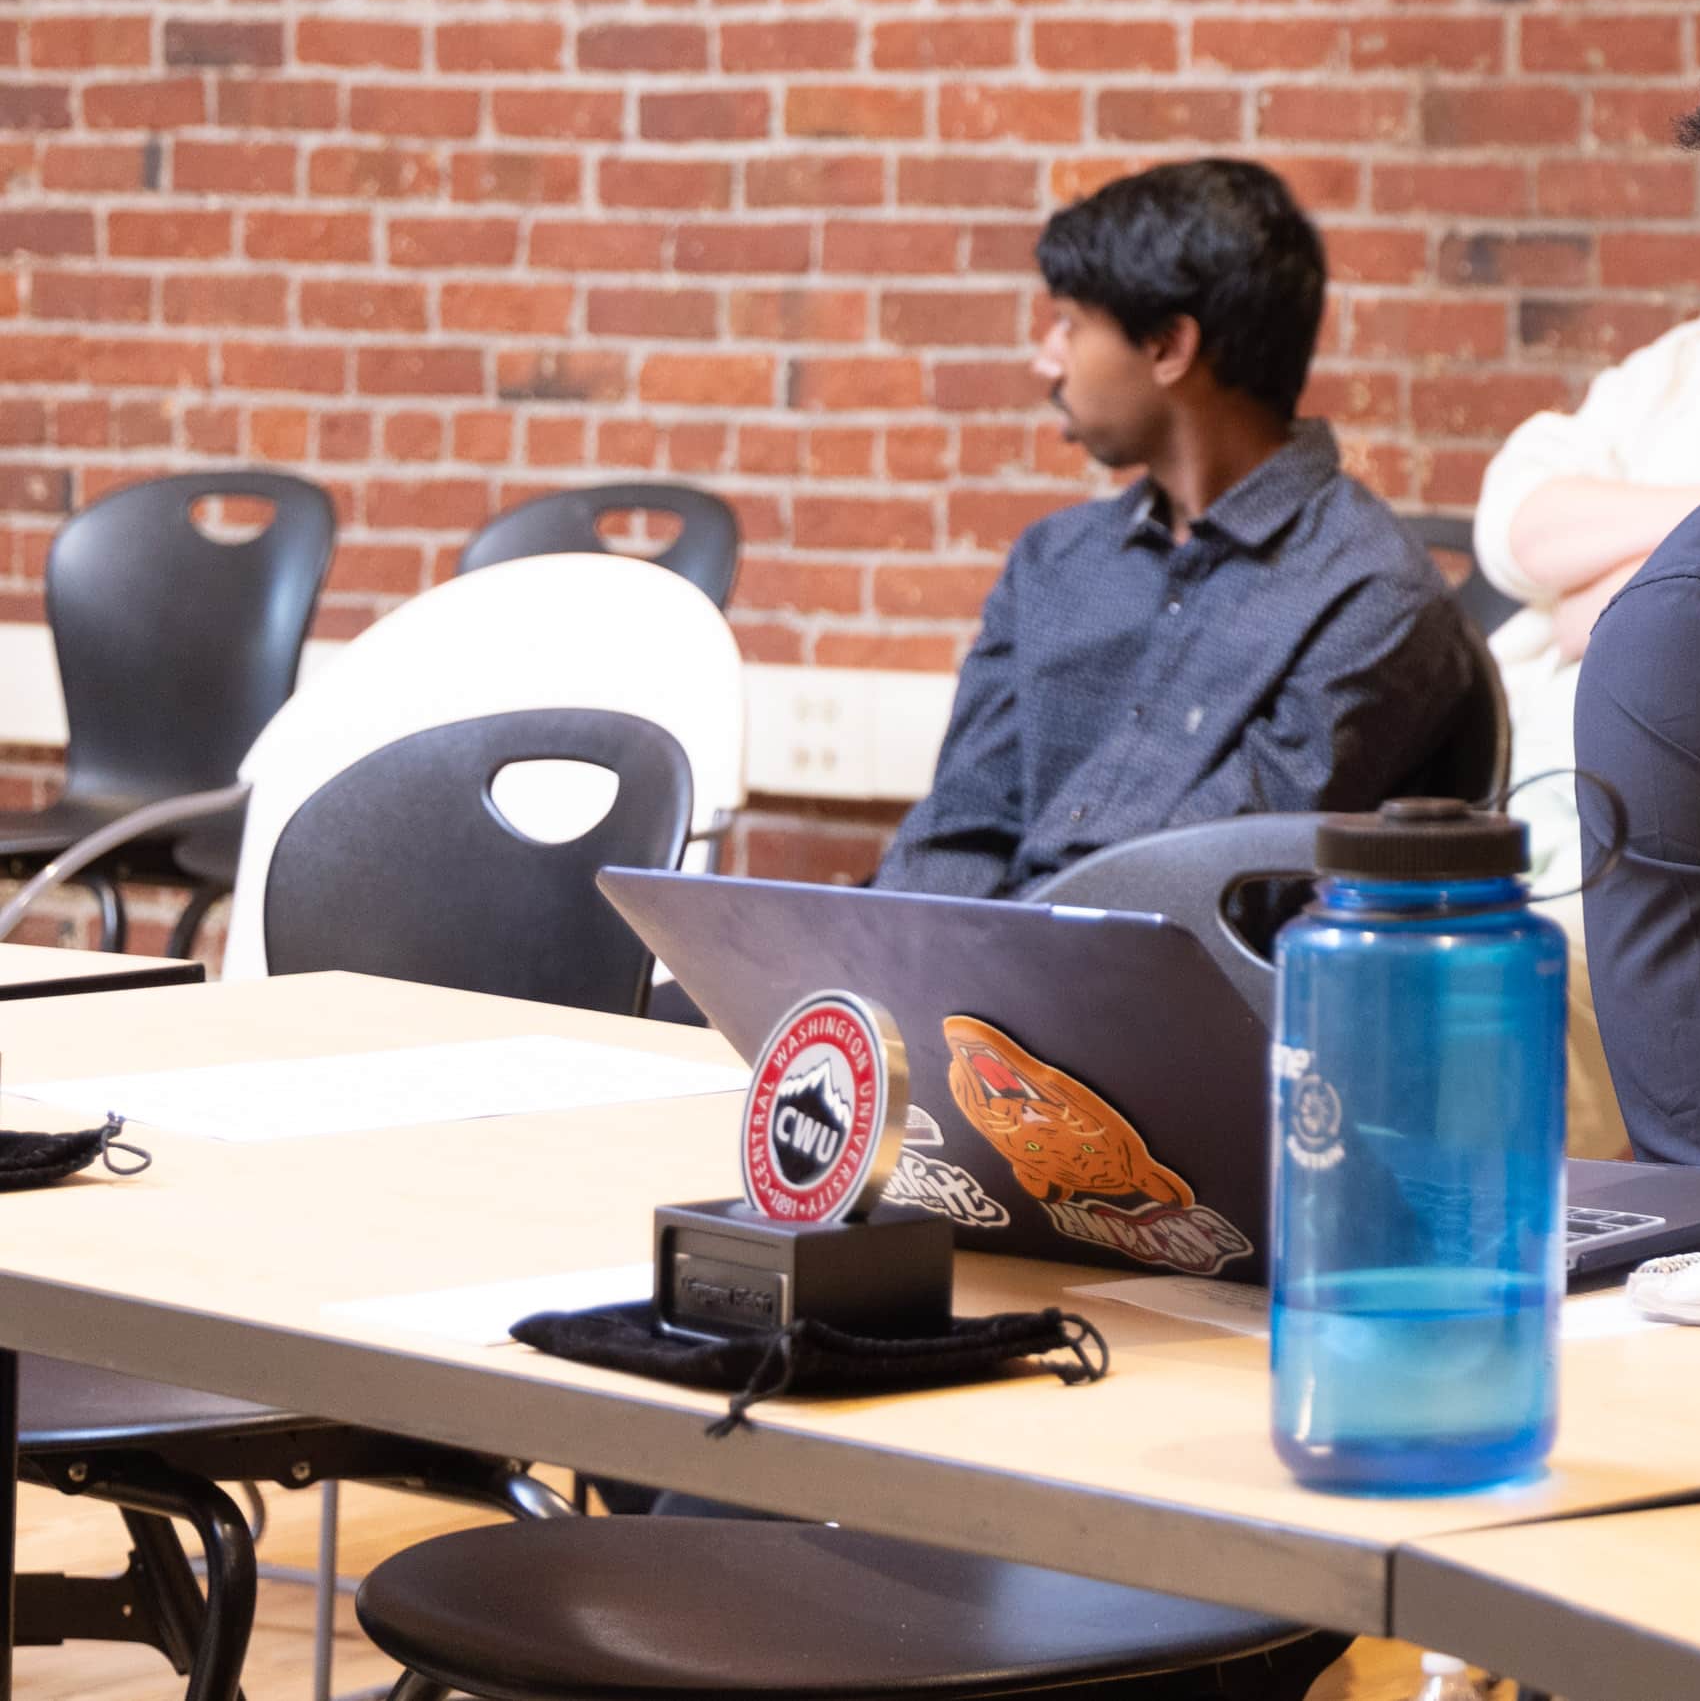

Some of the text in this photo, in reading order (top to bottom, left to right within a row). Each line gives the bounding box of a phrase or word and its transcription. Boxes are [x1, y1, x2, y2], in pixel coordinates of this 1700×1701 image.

[751, 1015, 872, 1217] CENTRAL WASHINGTON UNIVERSITY
[776, 1106, 838, 1163] CWU
